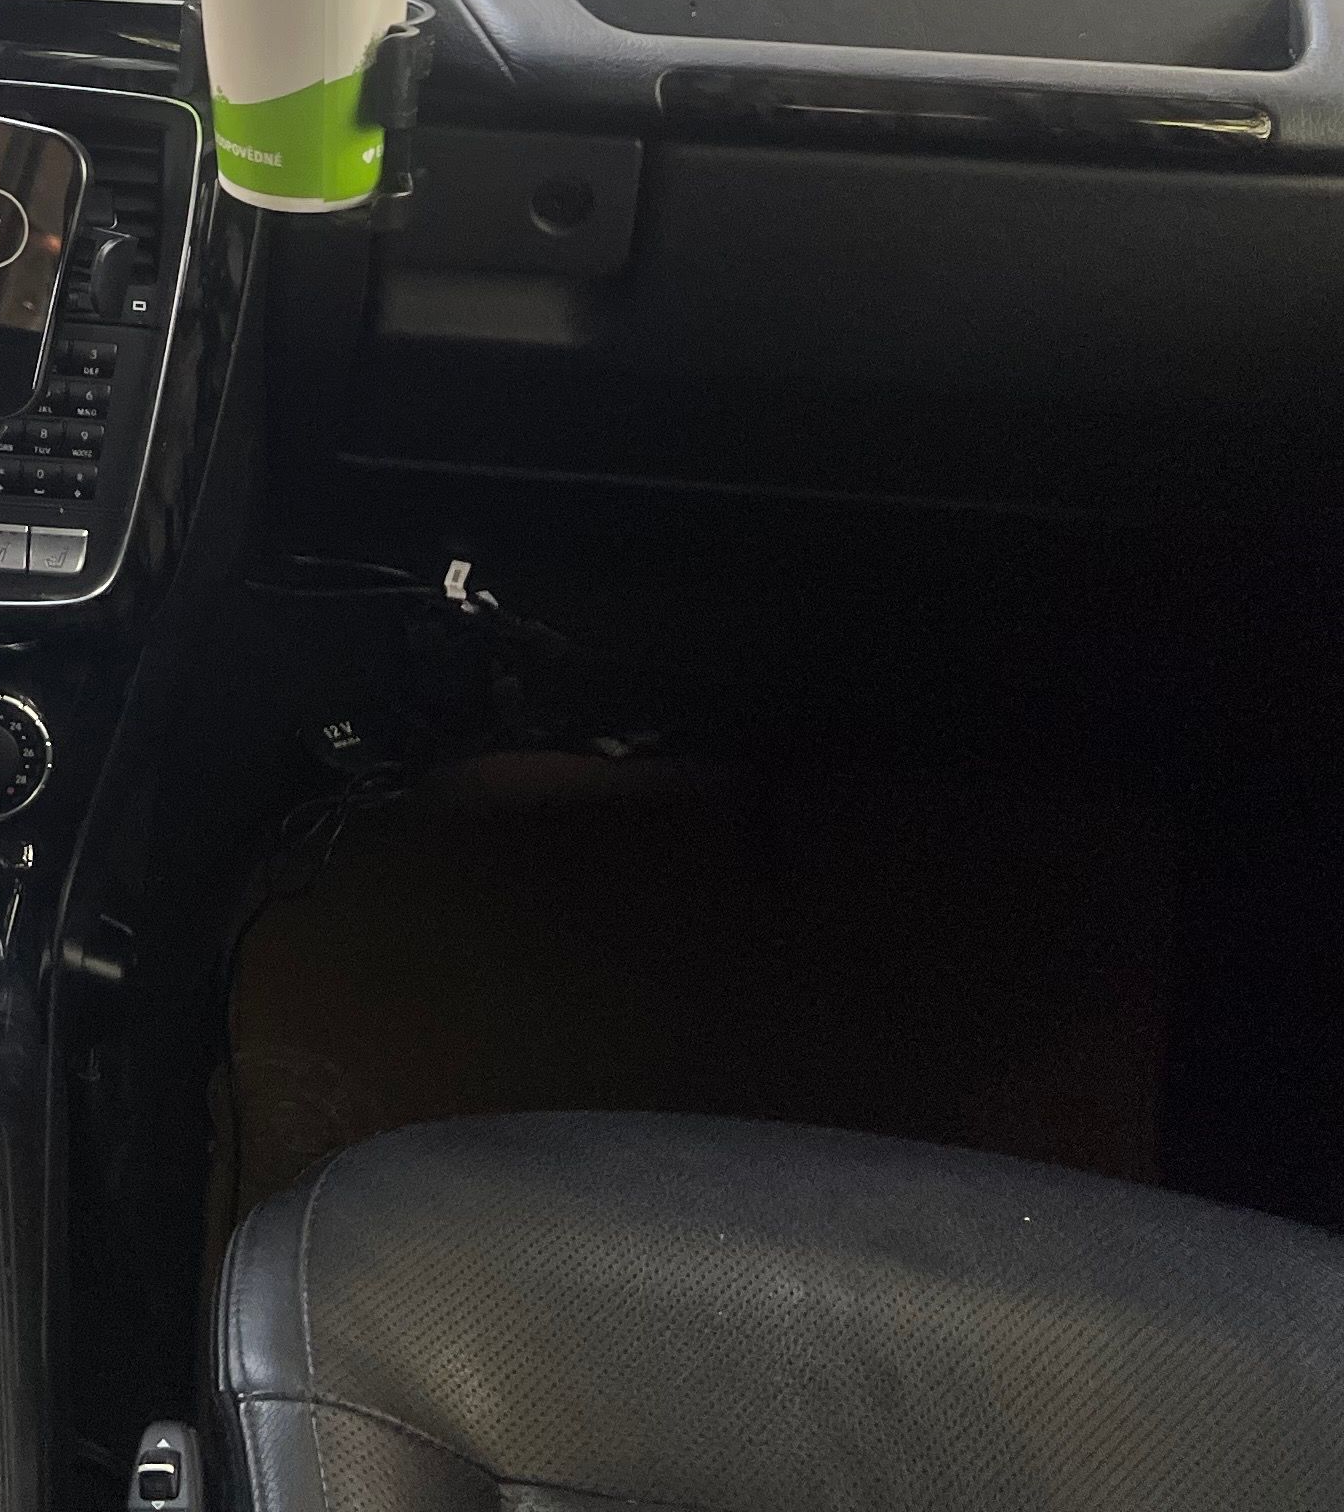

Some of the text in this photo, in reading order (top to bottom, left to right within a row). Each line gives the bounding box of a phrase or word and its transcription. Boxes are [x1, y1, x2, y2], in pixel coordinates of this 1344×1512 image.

[89, 349, 97, 359] 3
[83, 367, 100, 375] DEF
[85, 391, 93, 400] 6
[40, 428, 48, 438] 8
[81, 431, 89, 440] 9
[37, 469, 44, 479] 0
[23, 748, 34, 757] 26
[16, 775, 27, 784] 28
